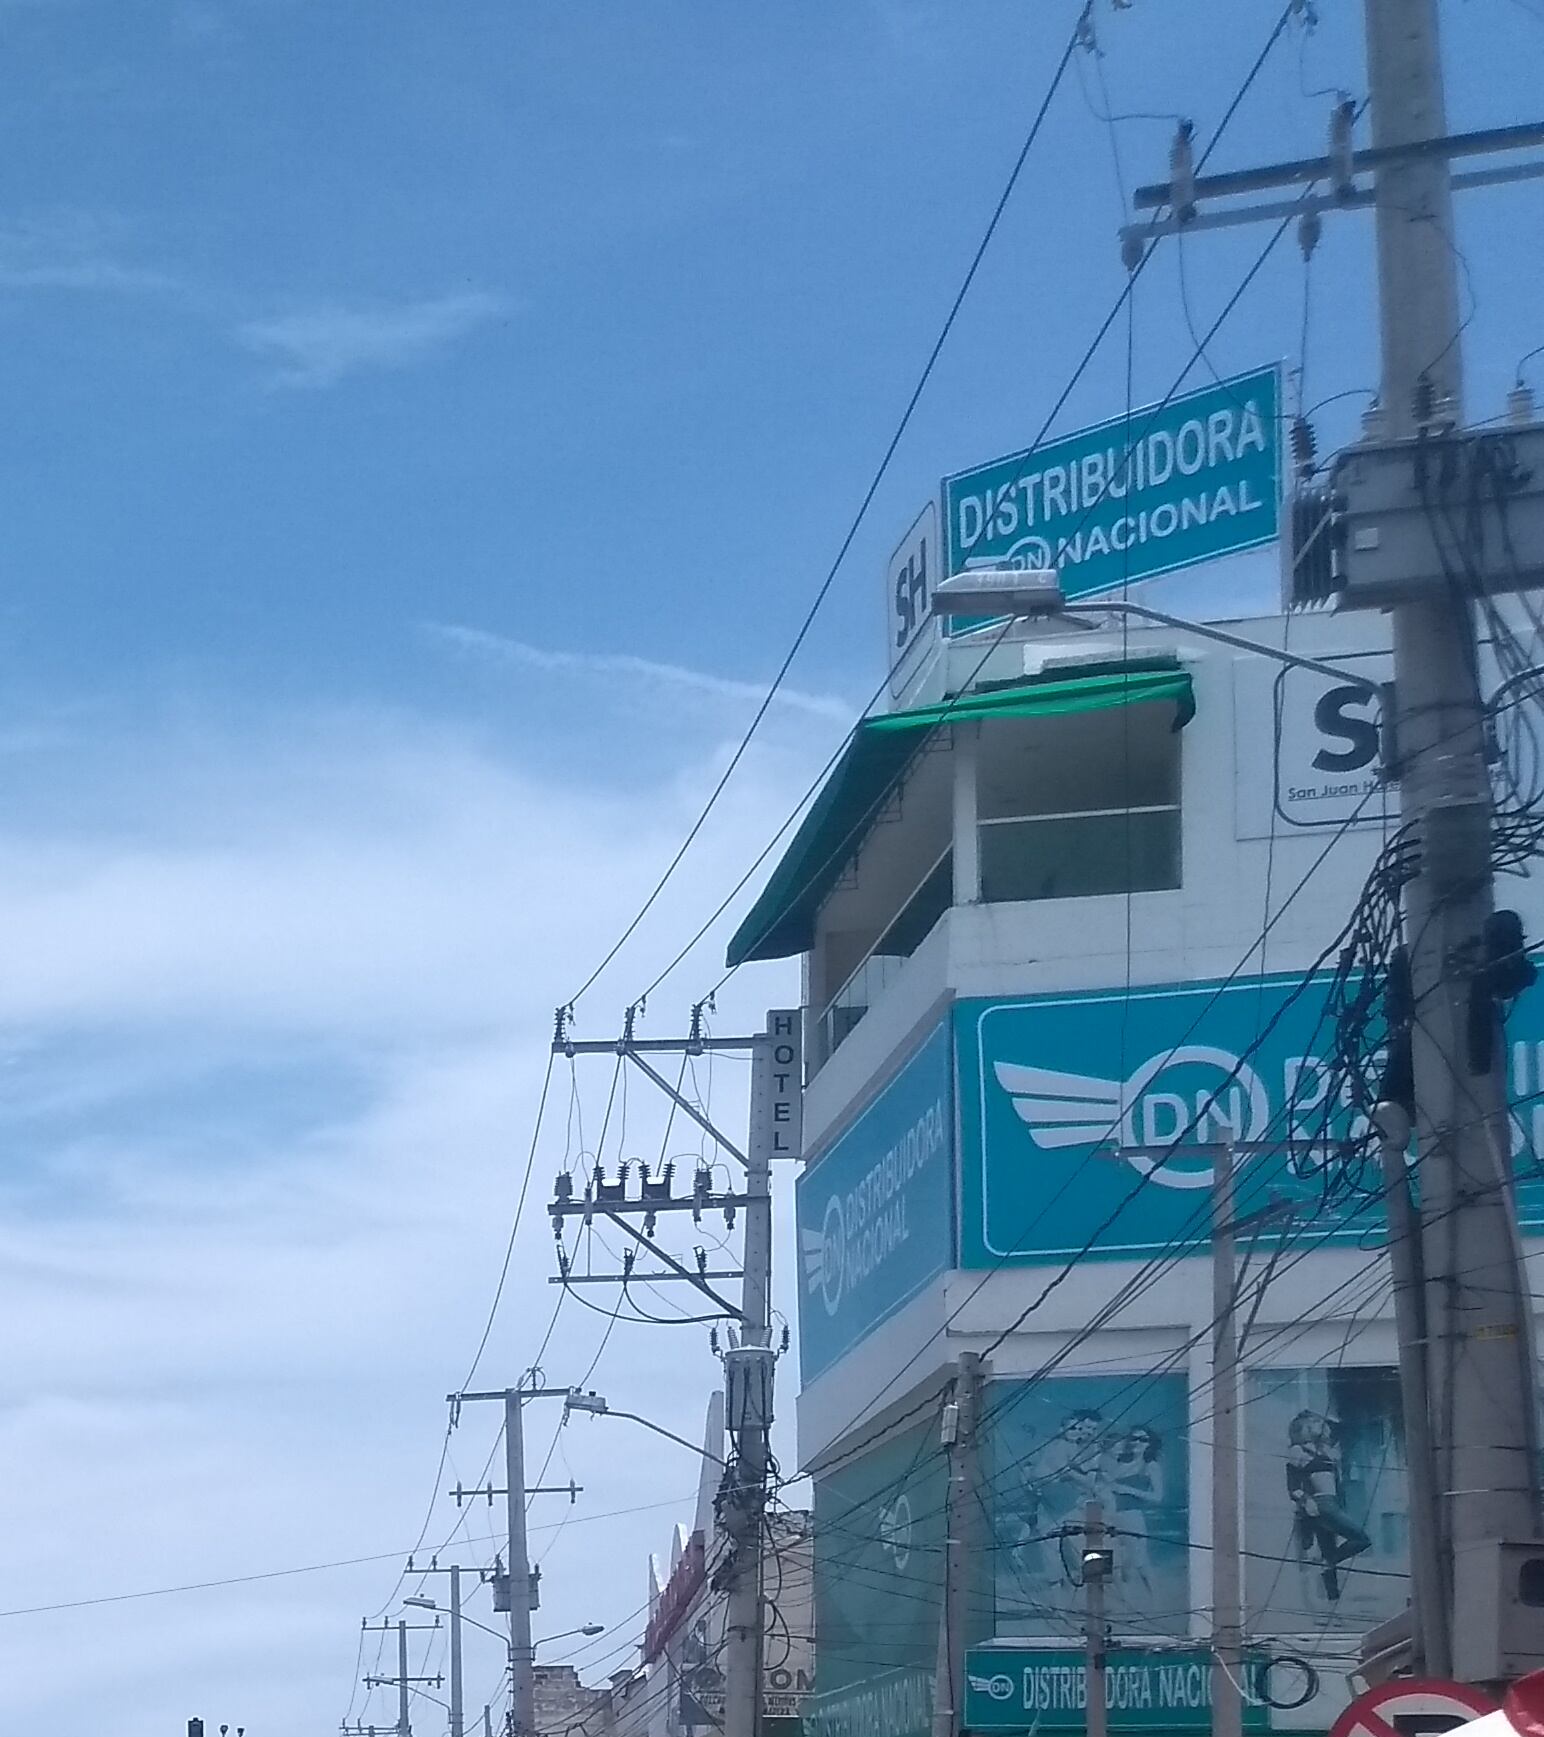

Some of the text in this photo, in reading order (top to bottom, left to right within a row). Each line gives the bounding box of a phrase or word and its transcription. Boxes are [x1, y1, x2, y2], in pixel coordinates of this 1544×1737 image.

[959, 399, 1264, 549] DISTRIBUIDORA
[1057, 480, 1262, 568] NACIONAL
[1288, 786, 1316, 799] San
[1320, 783, 1357, 797] Juan
[773, 1016, 794, 1151] HOTEL
[845, 1097, 944, 1241] DISTRIBUIDORA
[845, 1192, 910, 1291] NACIONAL
[1023, 1666, 1258, 1710] DISTRIBDORA NACIAL
